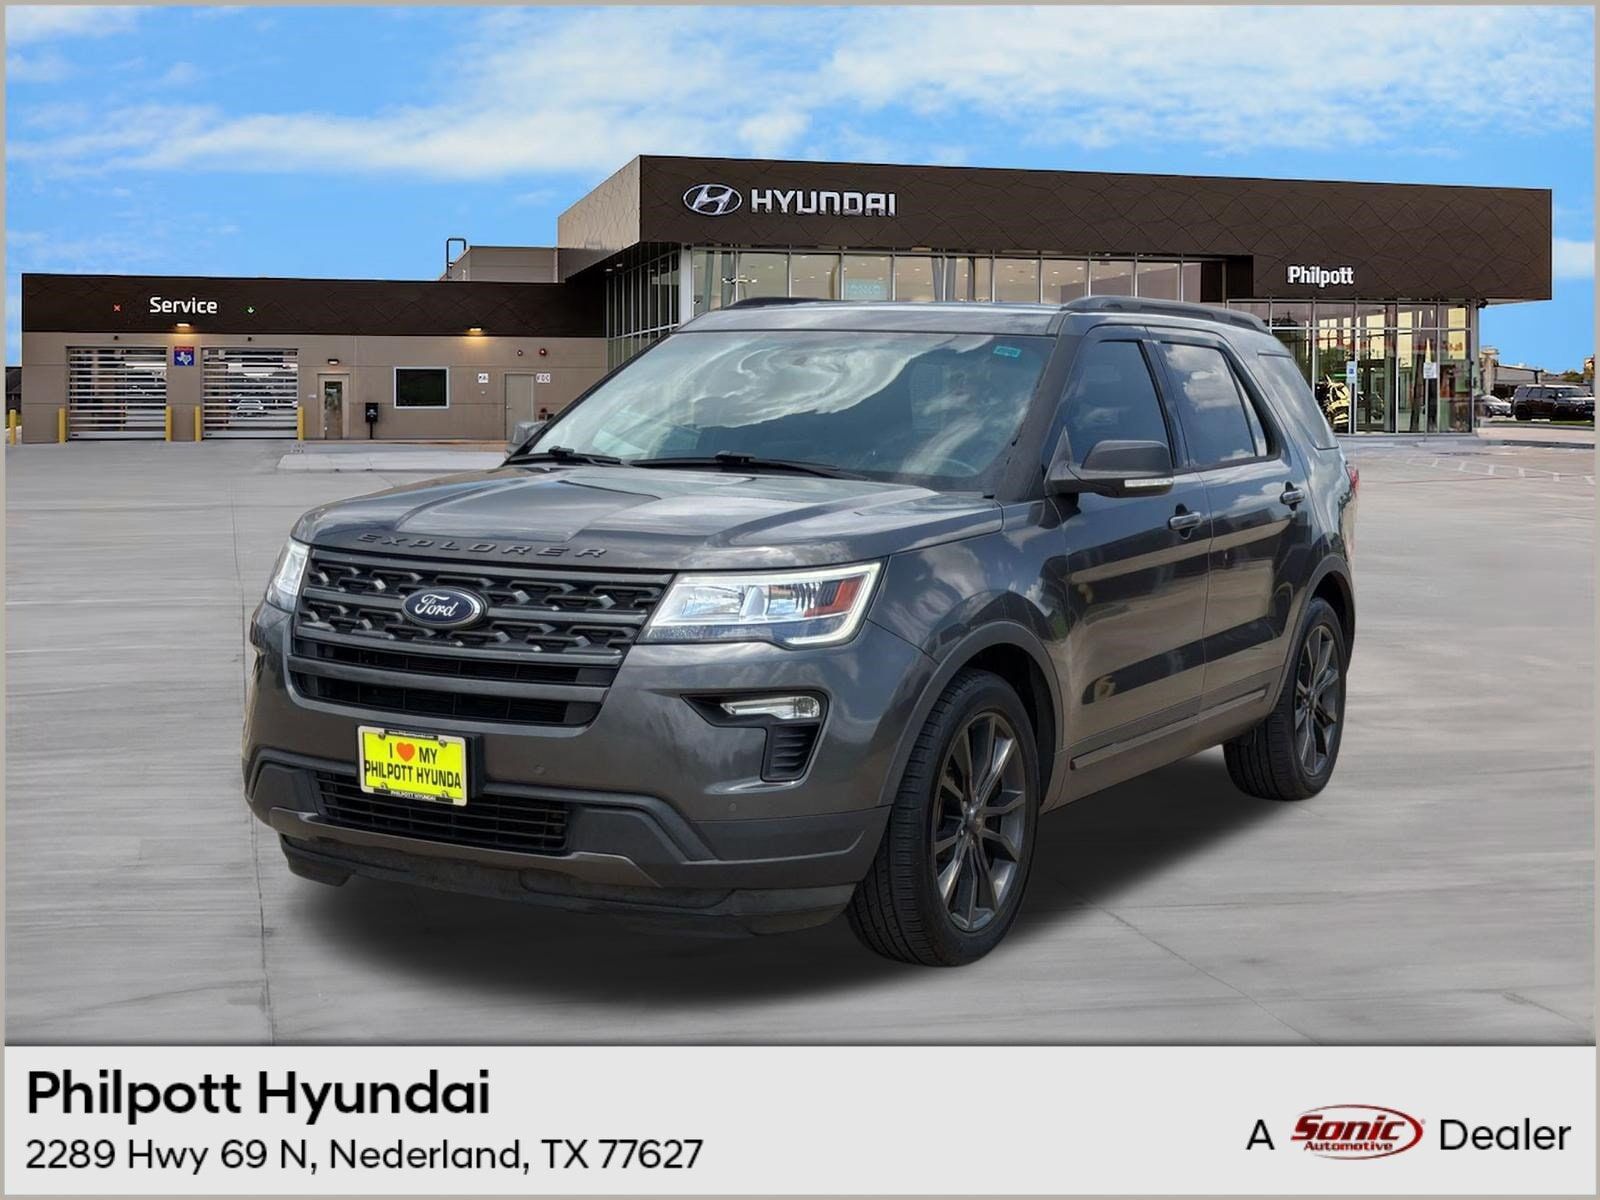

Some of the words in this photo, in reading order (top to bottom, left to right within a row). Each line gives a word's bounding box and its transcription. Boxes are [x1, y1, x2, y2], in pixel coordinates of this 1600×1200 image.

[751, 189, 896, 217] HYUNDAI
[1287, 265, 1354, 287] Philpott
[149, 296, 218, 314] Service
[357, 533, 607, 558] EXPLORER
[414, 594, 457, 617] Ford
[389, 742, 393, 759] I
[418, 746, 438, 765] MY
[364, 760, 413, 781] PHILPOTT
